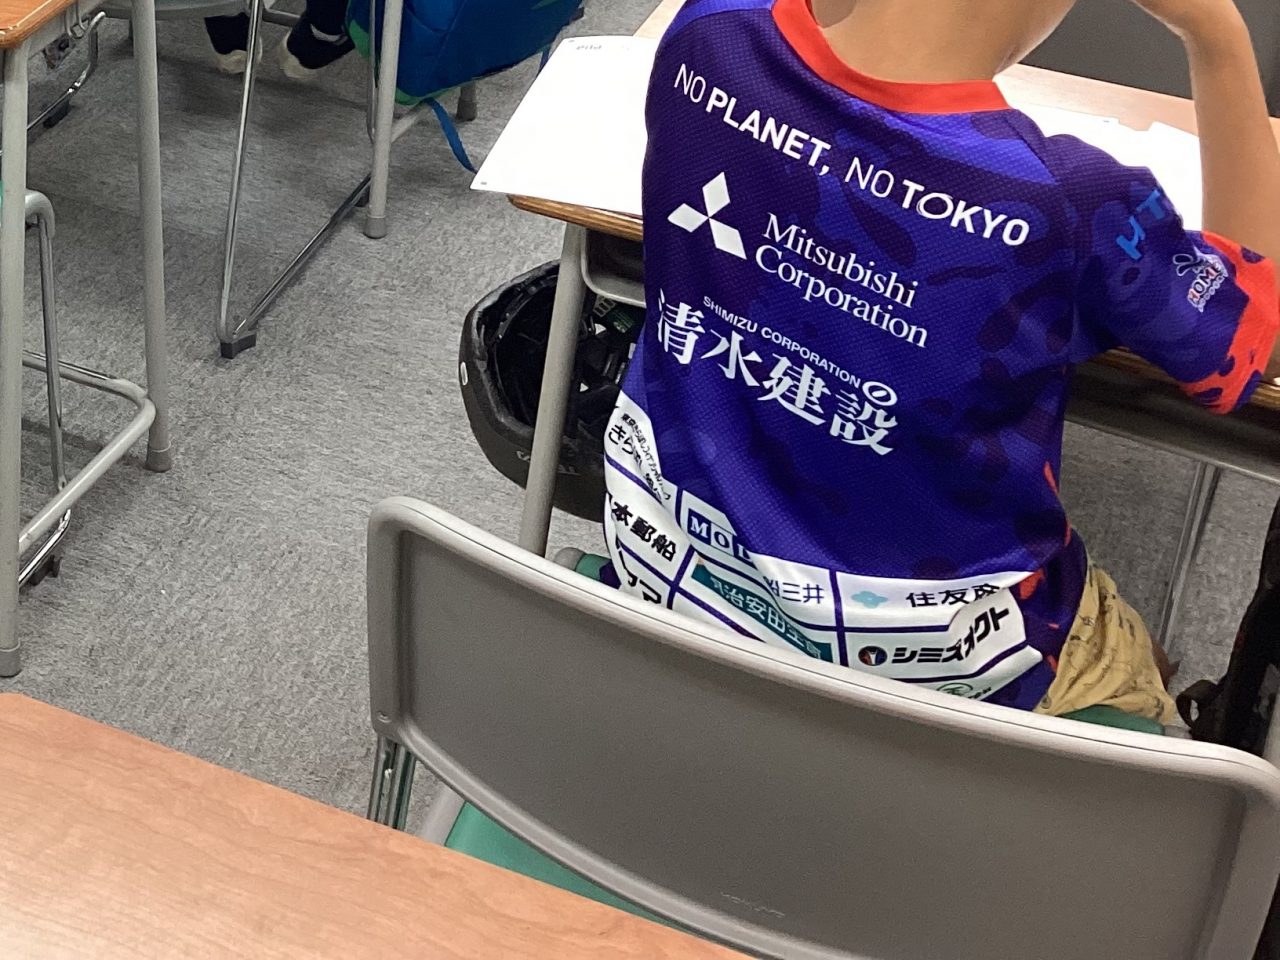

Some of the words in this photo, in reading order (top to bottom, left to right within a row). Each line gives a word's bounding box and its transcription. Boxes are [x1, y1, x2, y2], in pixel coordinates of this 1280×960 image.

[674, 63, 707, 103] NO
[705, 87, 831, 176] PLANET,
[844, 157, 895, 198] NO
[901, 179, 1029, 246] TOKYO
[755, 244, 928, 347] Corporation
[762, 212, 918, 308] Mitsubishi
[657, 288, 898, 456] 清水建設
[703, 296, 758, 333] SHIMIZU
[761, 327, 861, 388] CORPORATION
[608, 494, 677, 562] 本郵船
[892, 607, 1009, 664] シミズオクト
